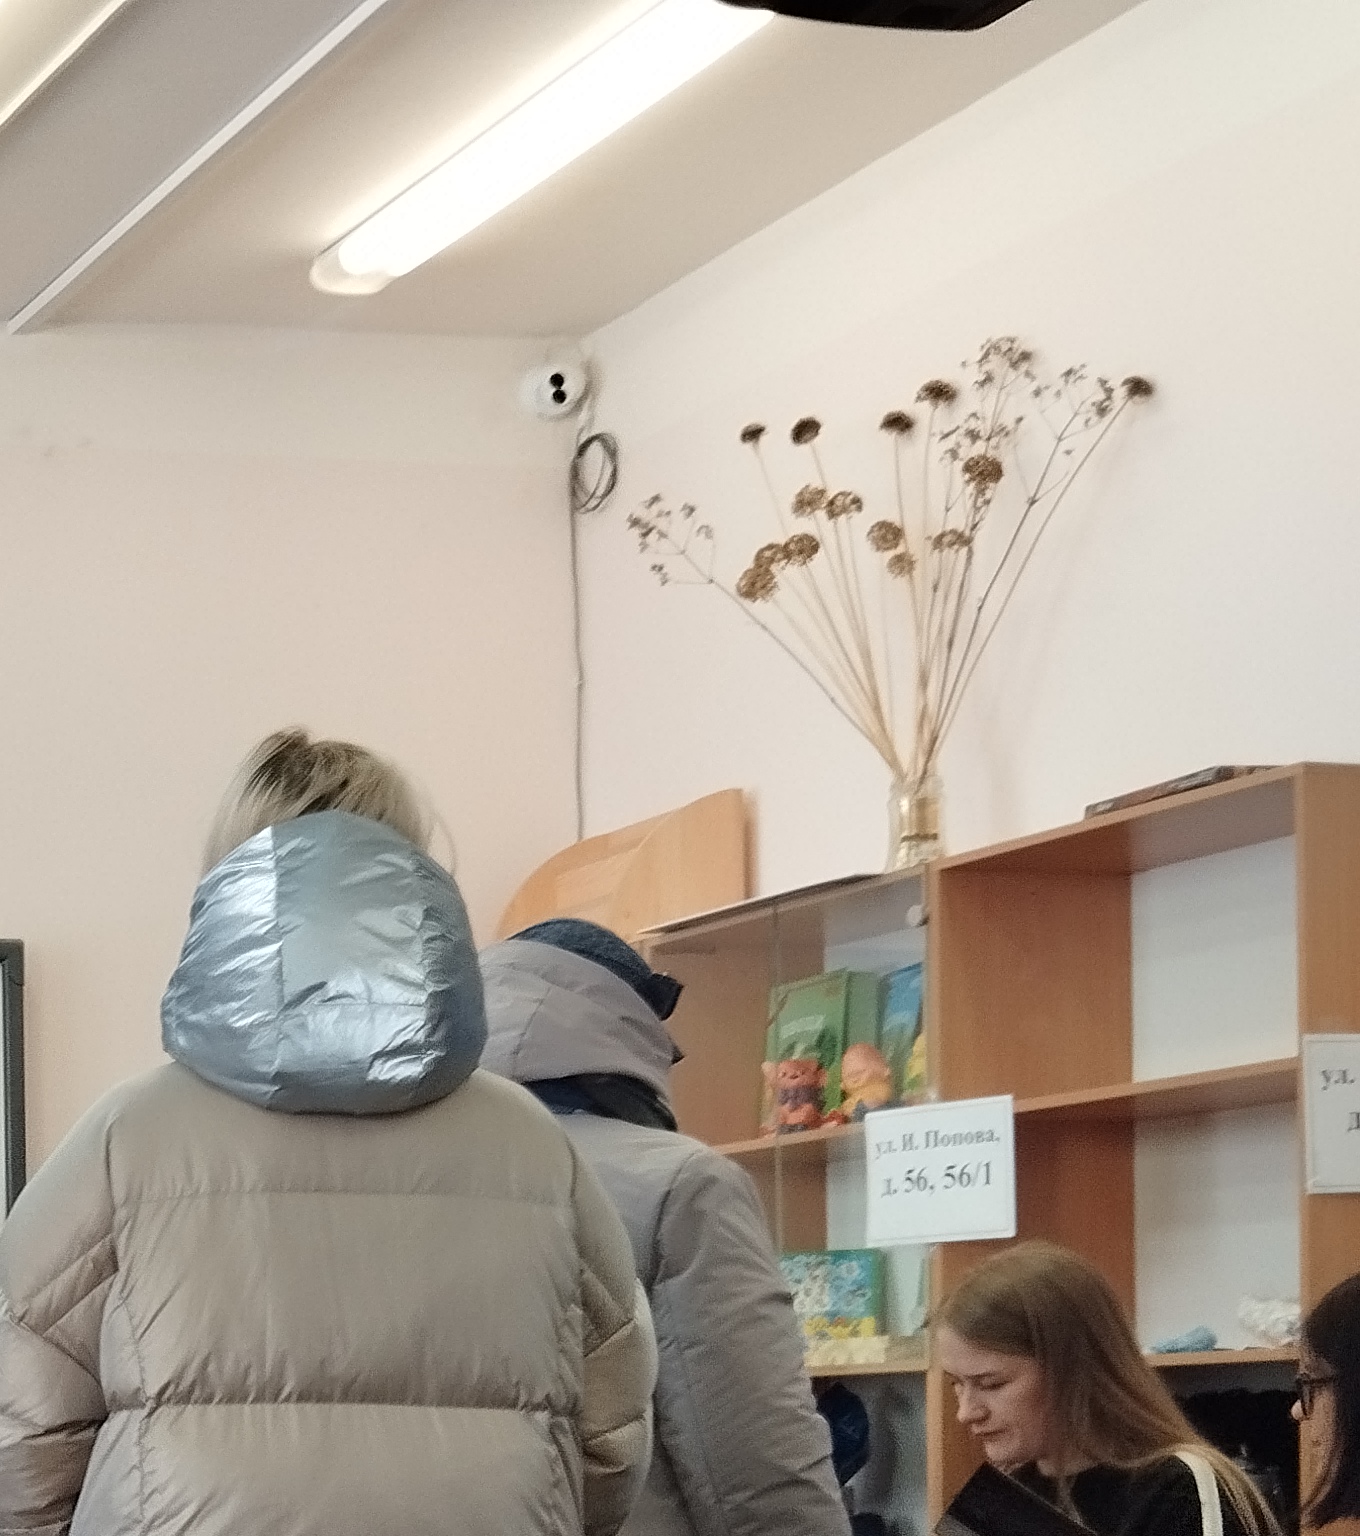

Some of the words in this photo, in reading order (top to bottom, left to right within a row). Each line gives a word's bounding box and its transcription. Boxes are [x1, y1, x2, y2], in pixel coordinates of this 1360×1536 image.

[1320, 1069, 1355, 1091] ул.
[880, 1178, 898, 1198] д.
[904, 1167, 936, 1197] 56,
[943, 1161, 991, 1190] 56/1
